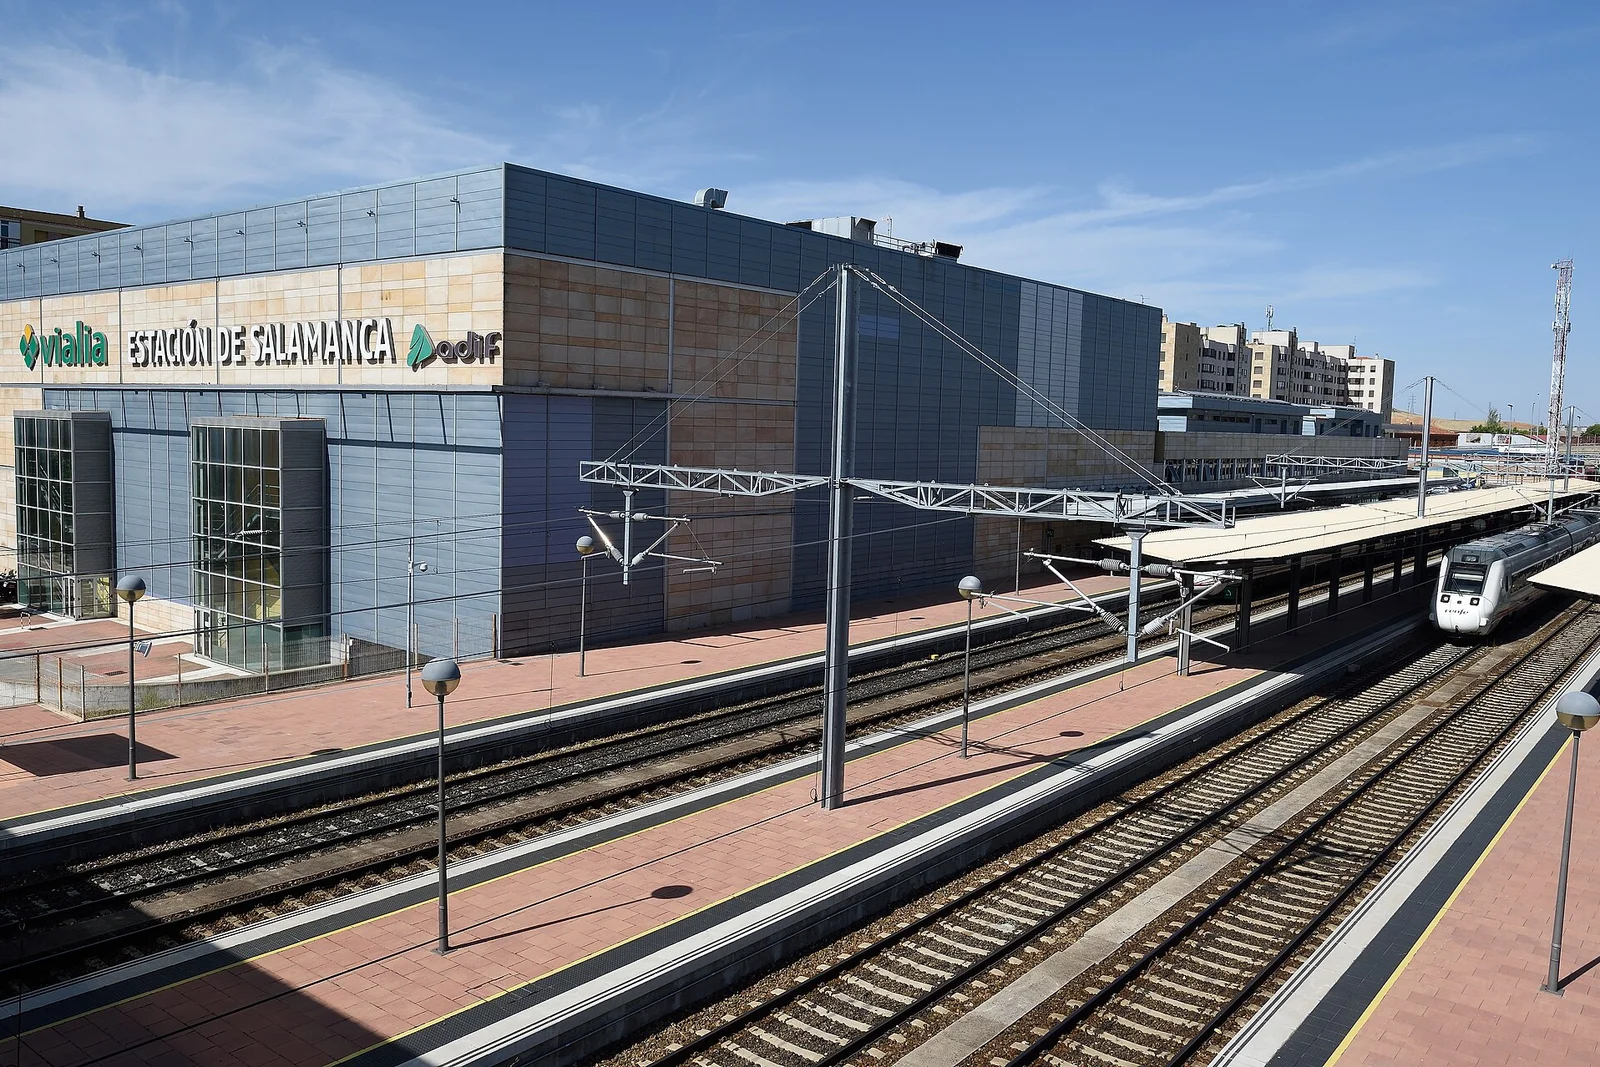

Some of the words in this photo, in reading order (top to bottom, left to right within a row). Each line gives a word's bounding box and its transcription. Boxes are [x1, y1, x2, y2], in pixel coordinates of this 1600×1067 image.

[39, 320, 108, 365] vialia
[127, 317, 212, 365] ESTACIÓN
[216, 325, 245, 364] DE
[250, 317, 395, 363] SALAMANCA
[436, 330, 501, 361] adif
